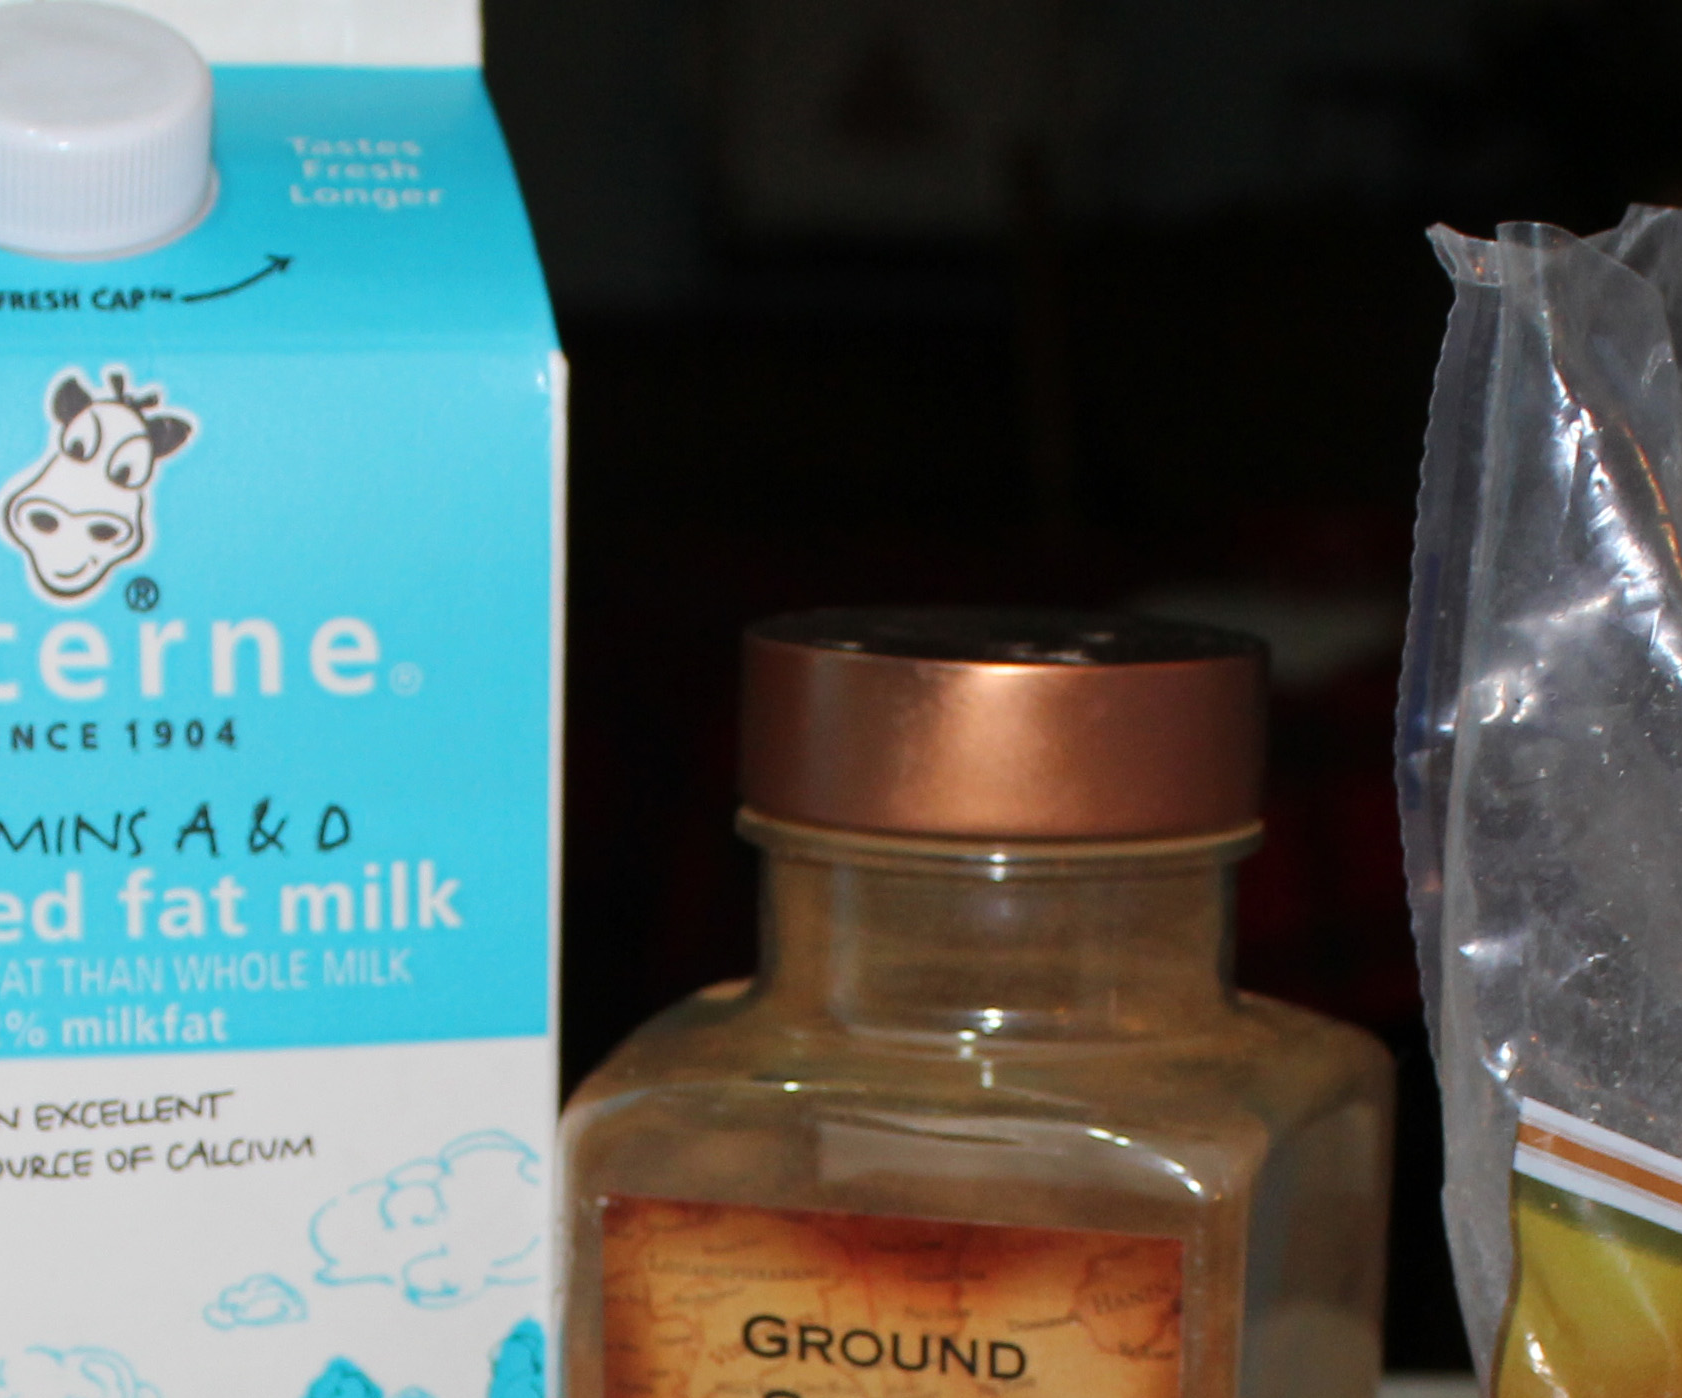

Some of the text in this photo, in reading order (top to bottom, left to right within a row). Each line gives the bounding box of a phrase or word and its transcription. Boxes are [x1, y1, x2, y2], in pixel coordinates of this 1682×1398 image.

[286, 136, 421, 155] Tastes
[302, 159, 420, 179] Fresh
[289, 184, 445, 210] Longer
[125, 717, 239, 749] 1904
[175, 802, 221, 857] A
[246, 797, 290, 856] &
[316, 802, 353, 853] D
[118, 868, 248, 942] fat
[279, 861, 463, 935] milk
[57, 956, 166, 996] THAN
[173, 951, 310, 994] WHOLE
[321, 947, 414, 988] MILK
[61, 1005, 229, 1047] milkfat
[34, 1089, 235, 1132] EXCELLENT
[106, 1145, 154, 1173] OF
[167, 1134, 316, 1172] CALCIUM
[740, 1313, 1029, 1383] GROUND
